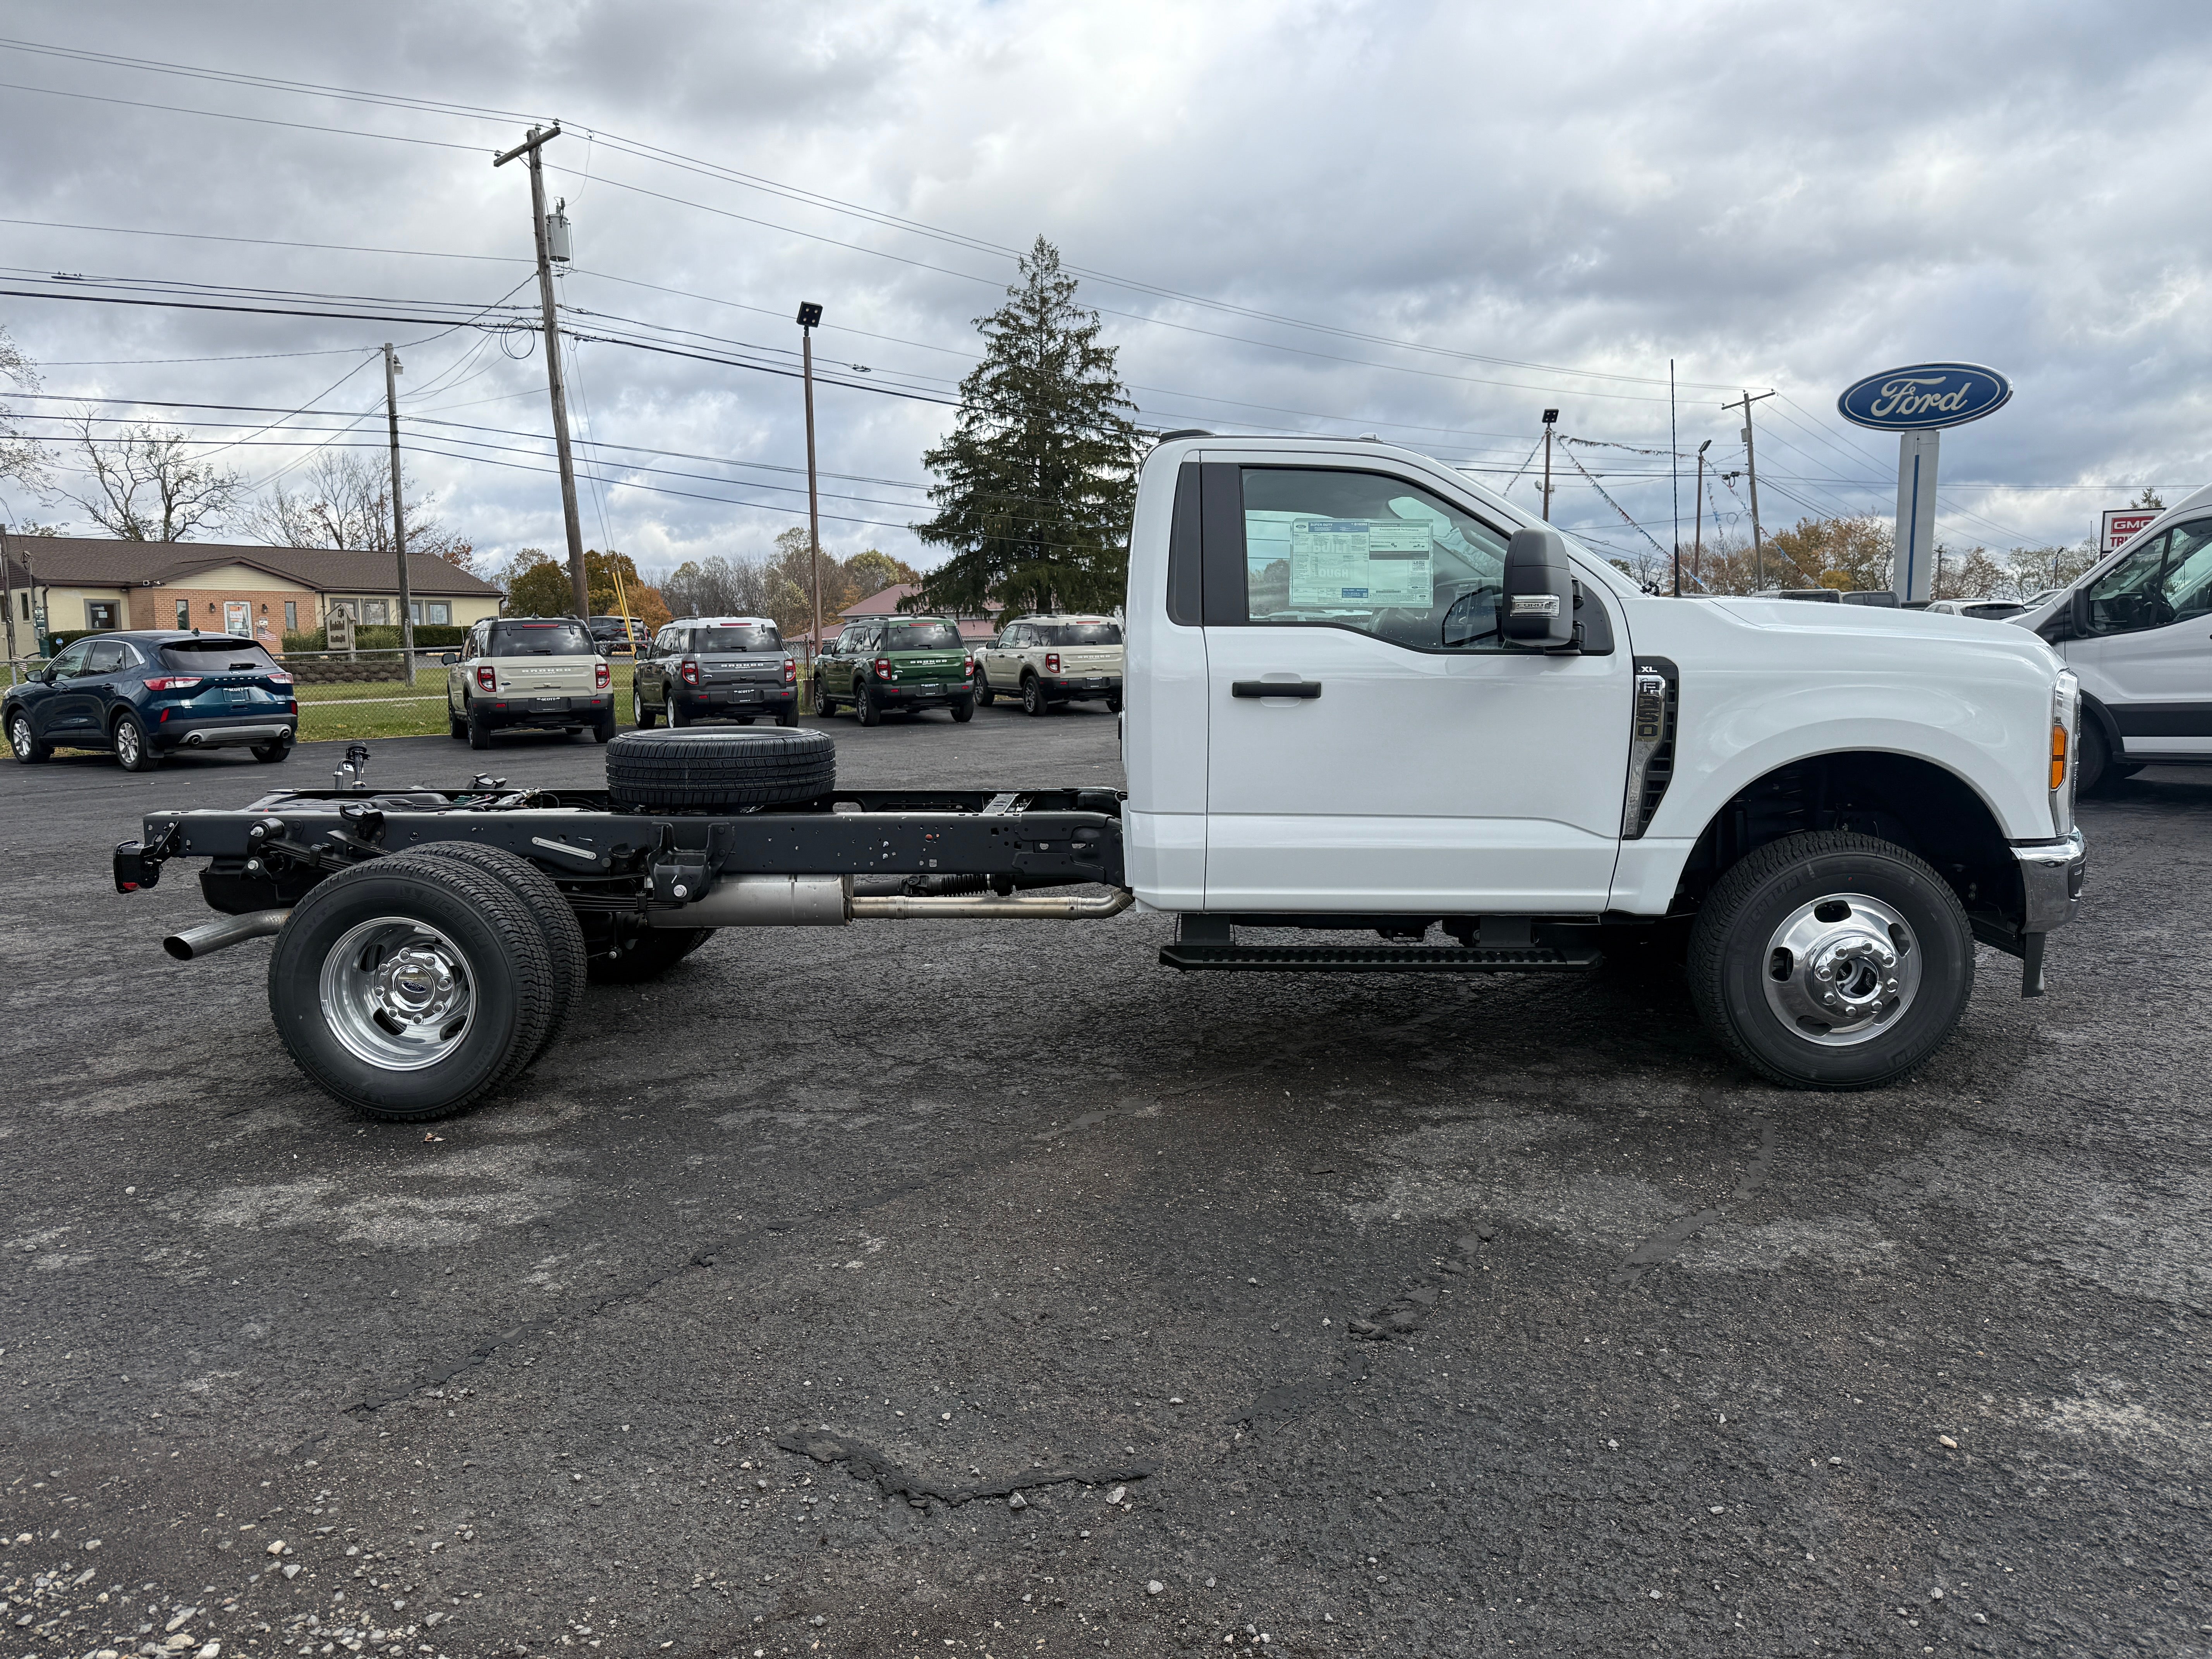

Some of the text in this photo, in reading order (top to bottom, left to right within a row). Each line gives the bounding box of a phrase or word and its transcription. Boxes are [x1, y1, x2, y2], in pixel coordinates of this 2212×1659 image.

[1870, 376, 1971, 417] Ford
[2114, 520, 2152, 529] GMC
[419, 892, 489, 945] MICHELIN
[1740, 875, 1802, 941] MICHELIN
[1891, 1007, 1950, 1068] ICHELIN
[301, 1047, 368, 1099] MICHELIN
